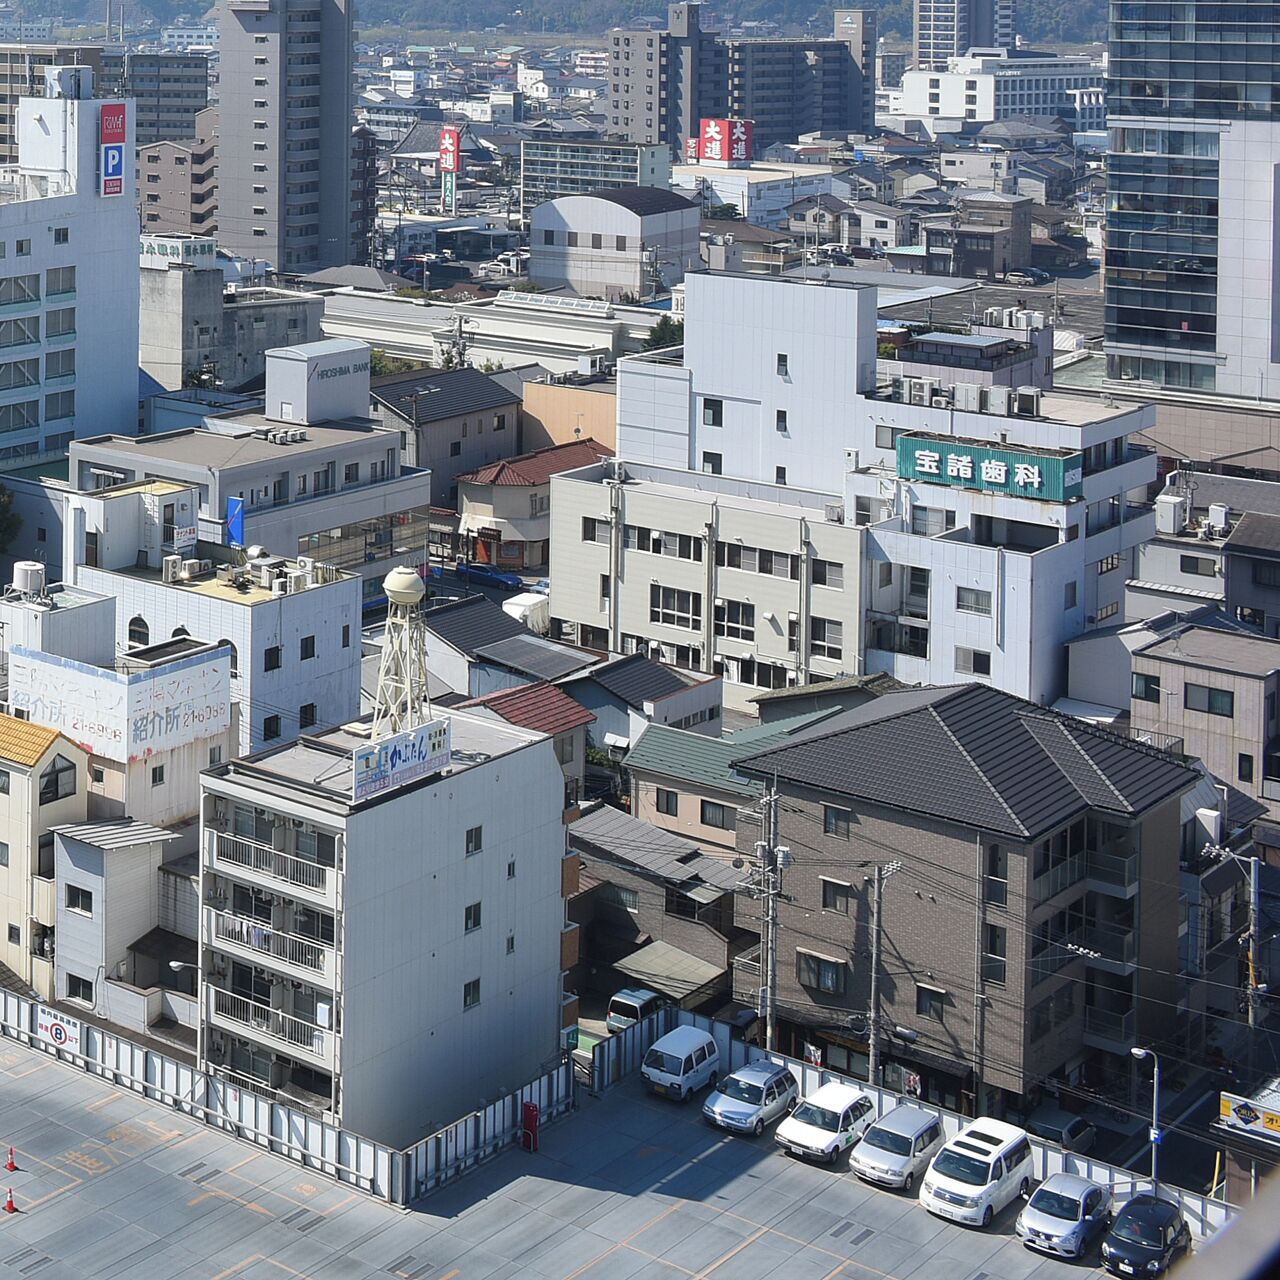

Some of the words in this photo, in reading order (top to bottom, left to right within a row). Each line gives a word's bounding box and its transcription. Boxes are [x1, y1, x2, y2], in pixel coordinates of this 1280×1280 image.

[440, 133, 455, 170] 大進
[704, 120, 723, 160] 大進
[732, 122, 747, 159] 大進
[108, 150, 119, 173] P
[317, 365, 351, 381] HIROSHIMA
[353, 362, 370, 373] BANK
[132, 704, 181, 744] 紹介所
[54, 1027, 63, 1040] 8
